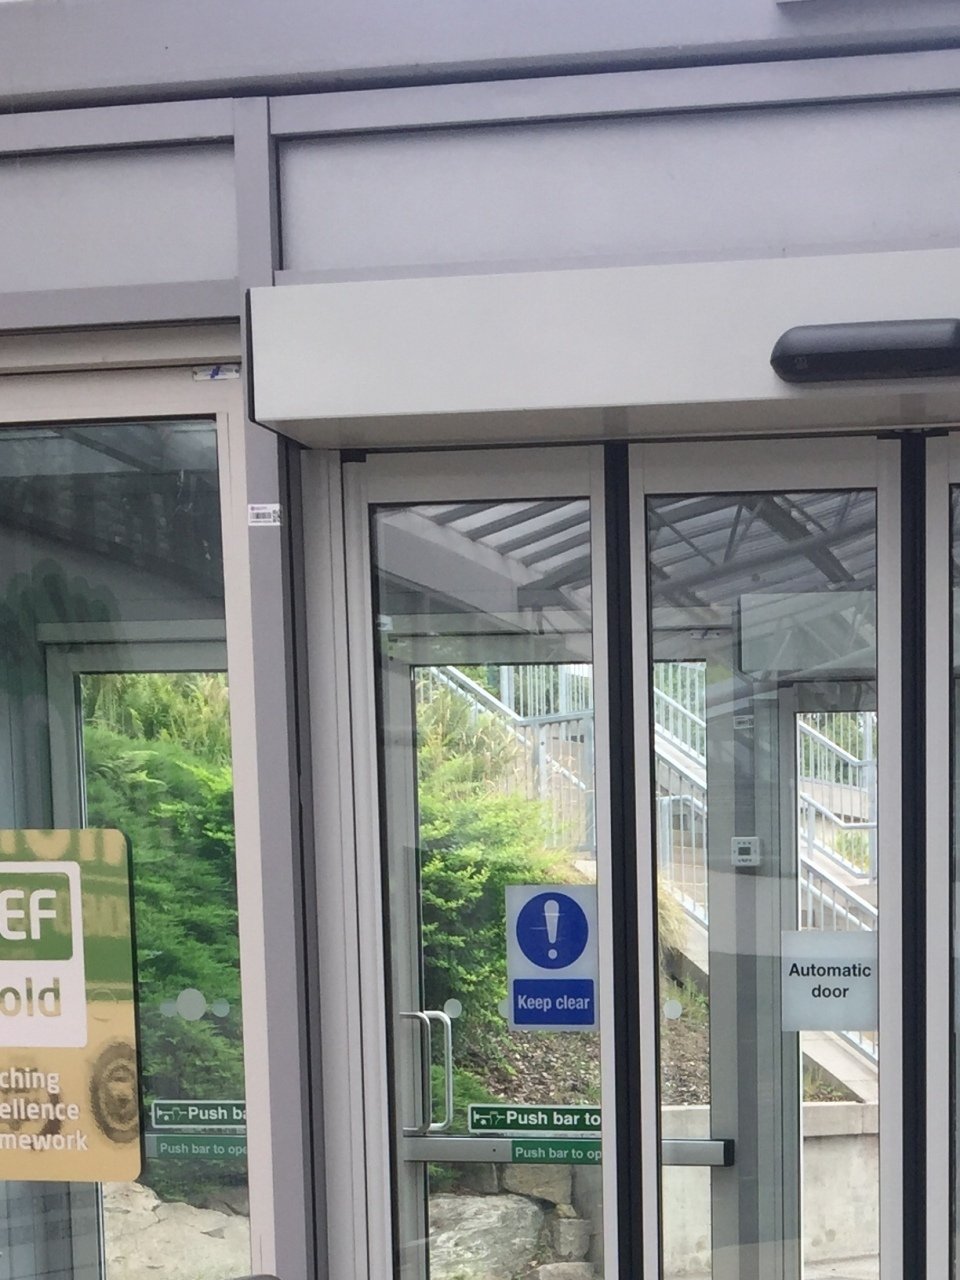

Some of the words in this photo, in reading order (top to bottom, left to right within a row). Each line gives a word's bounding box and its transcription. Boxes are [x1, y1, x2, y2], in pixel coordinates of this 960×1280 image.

[789, 962, 872, 978] Automatic
[0, 977, 61, 1017] old
[811, 985, 849, 998] door
[517, 995, 552, 1012] Keep
[556, 995, 590, 1010] clear
[188, 1106, 225, 1120] Push
[506, 1111, 548, 1125] Push
[553, 1112, 580, 1126] bar
[585, 1113, 602, 1126] to
[160, 1143, 189, 1154] Push
[192, 1143, 210, 1154] bar
[214, 1144, 225, 1154] to
[515, 1147, 546, 1159] Push
[549, 1147, 569, 1159] bar
[571, 1148, 583, 1159] to
